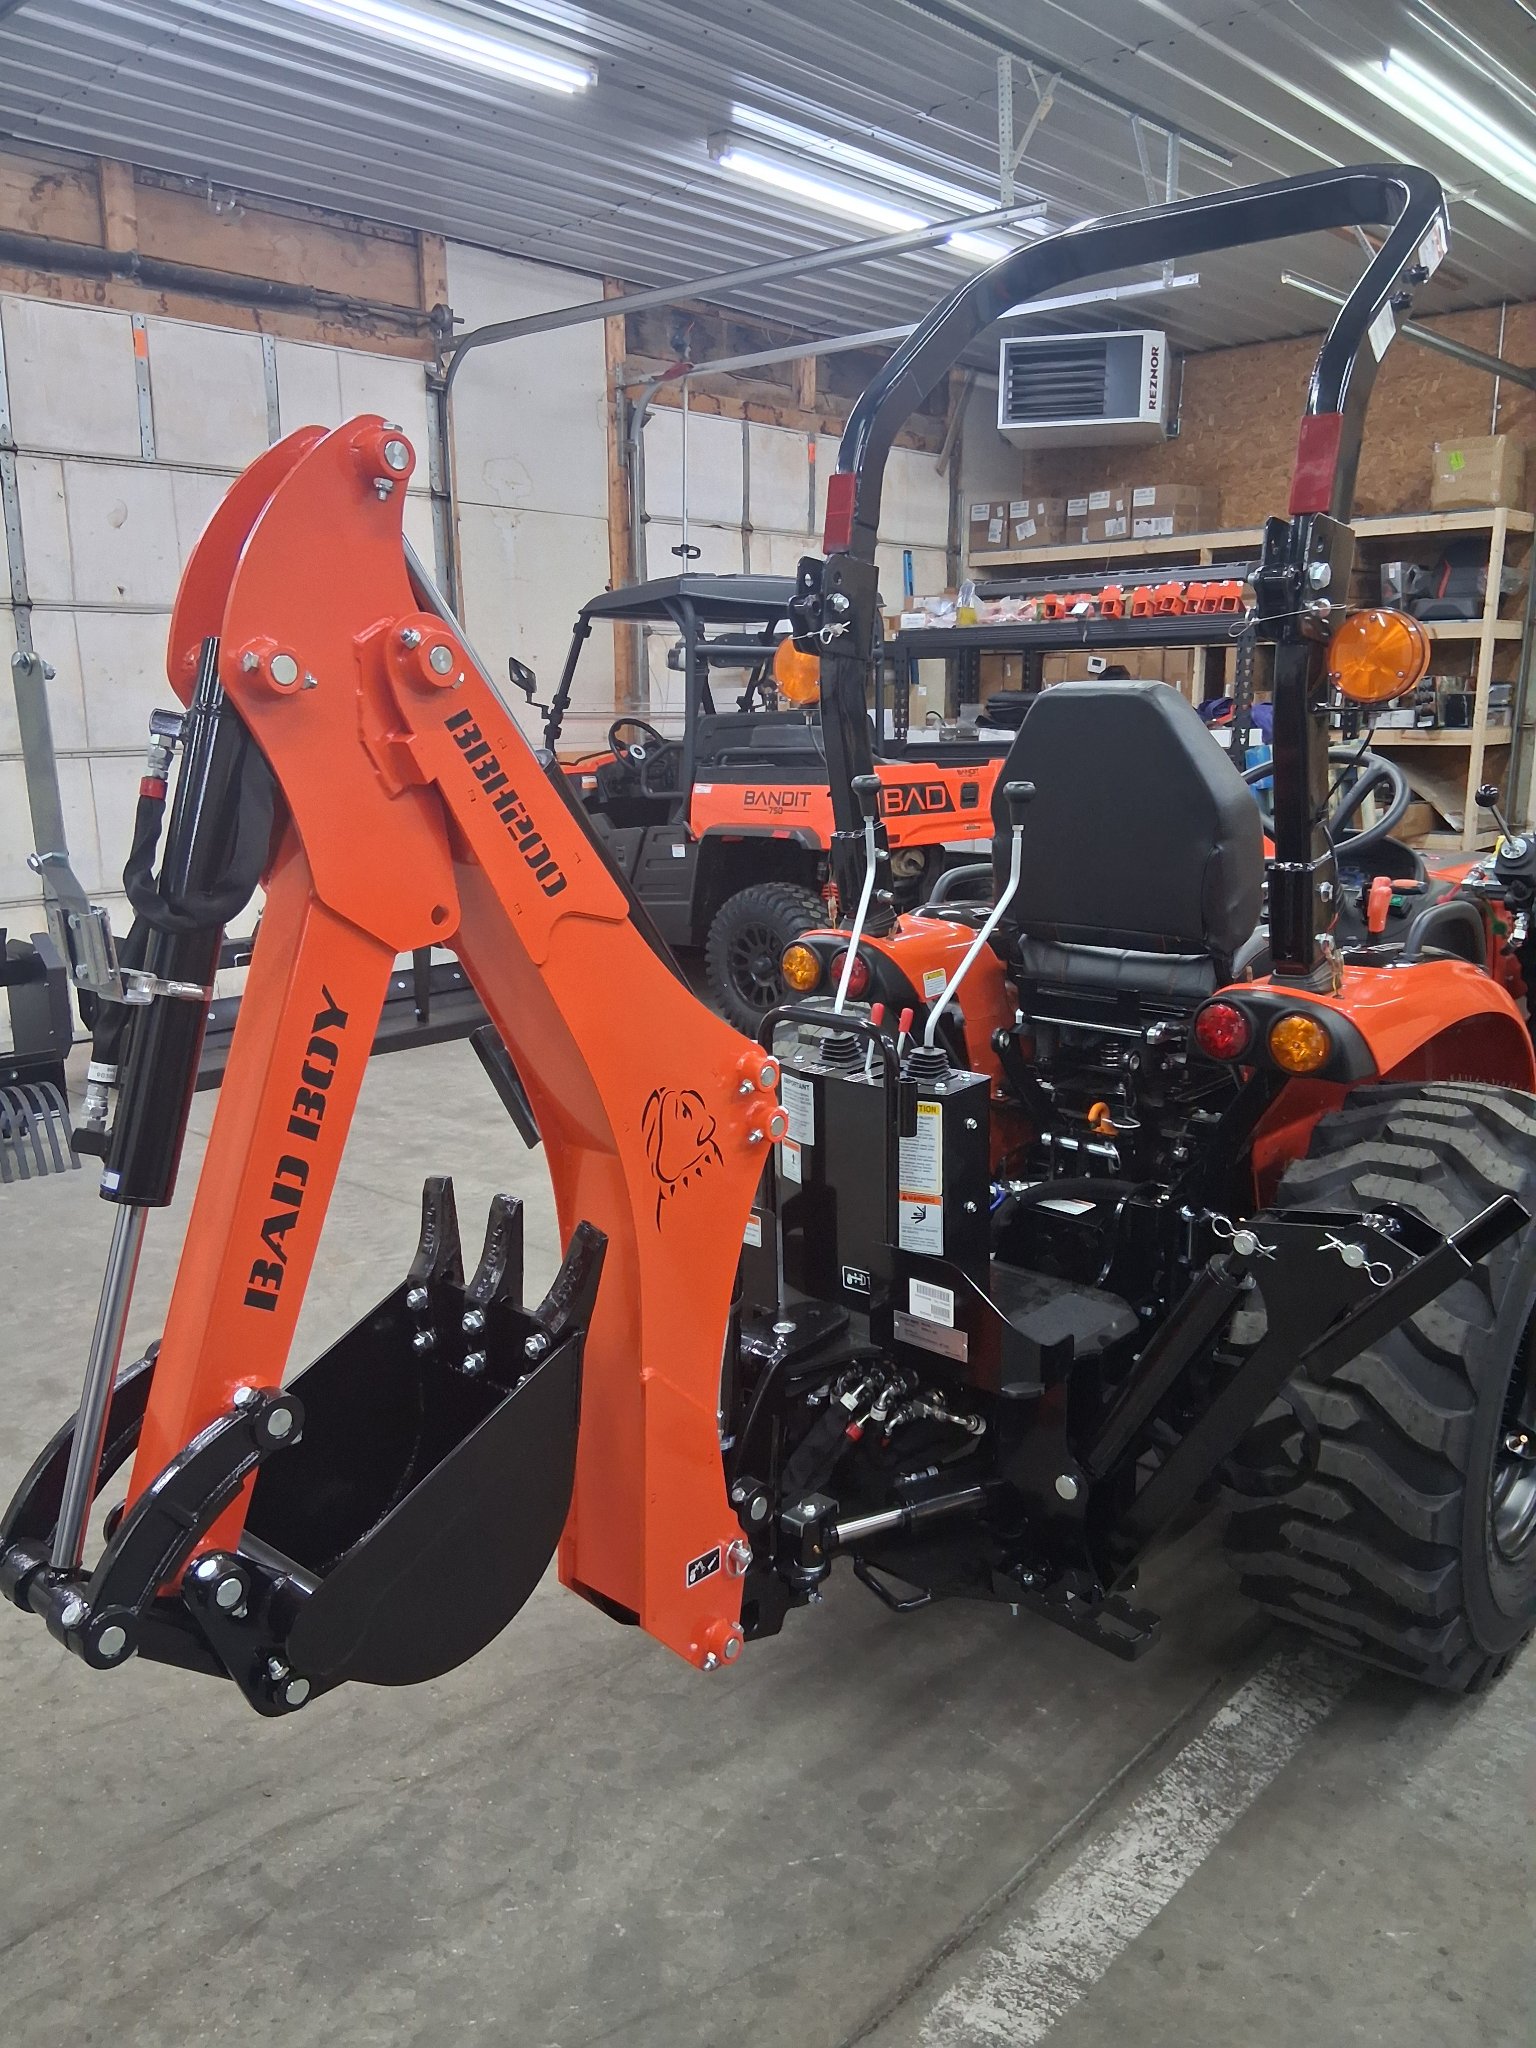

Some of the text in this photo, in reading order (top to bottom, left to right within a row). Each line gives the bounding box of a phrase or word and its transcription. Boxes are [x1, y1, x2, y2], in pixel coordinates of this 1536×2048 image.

[1148, 346, 1160, 410] REZNOR
[443, 708, 568, 898] BBH200
[744, 790, 811, 807] BANDIT
[768, 806, 784, 815] 750
[883, 785, 946, 813] BAD
[917, 1104, 937, 1113] TION
[243, 983, 349, 1312] BAD BOY
